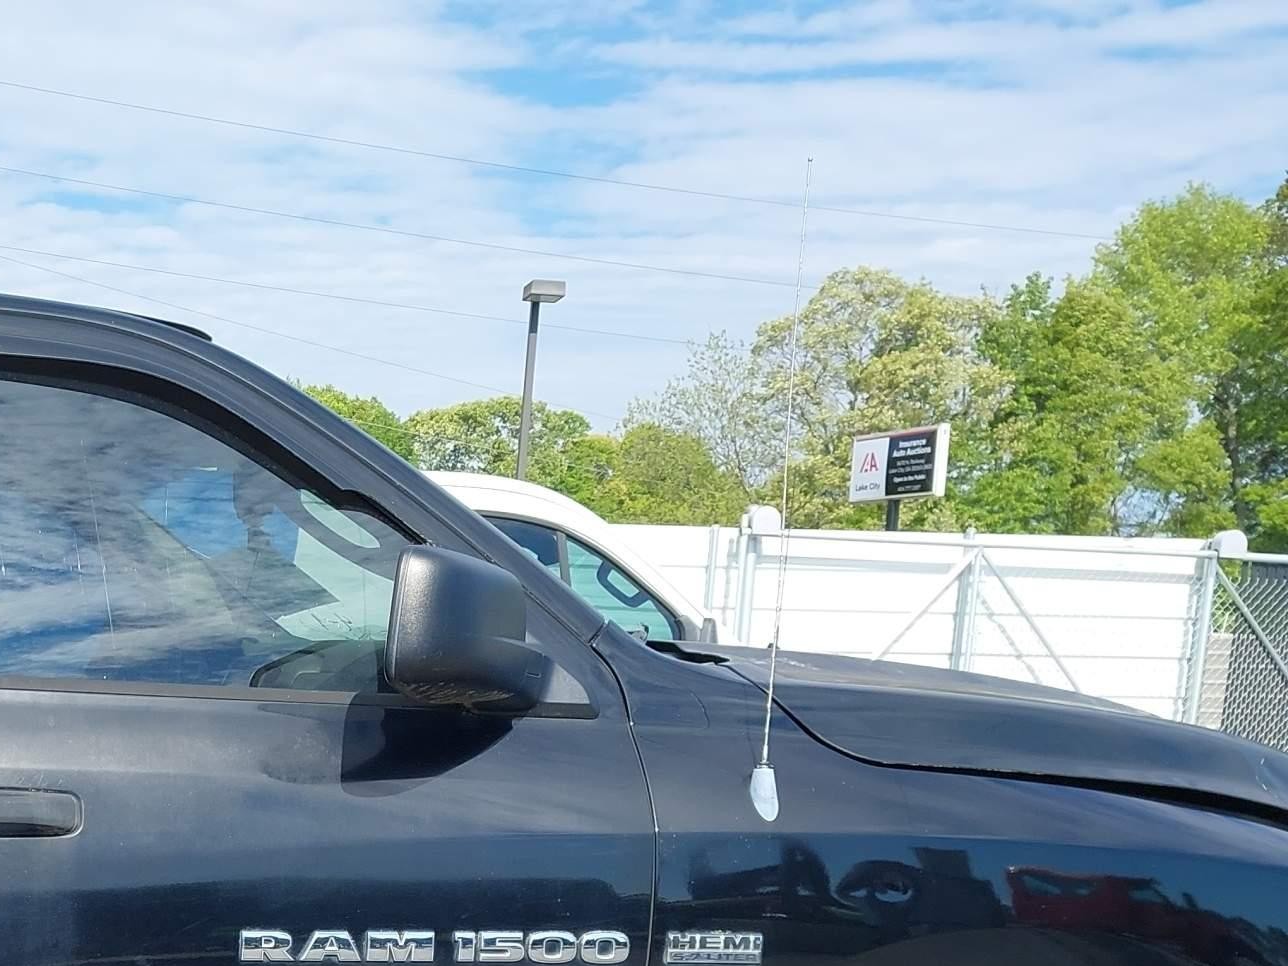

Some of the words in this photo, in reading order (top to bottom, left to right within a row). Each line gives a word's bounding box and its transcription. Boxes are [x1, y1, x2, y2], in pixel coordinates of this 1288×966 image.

[855, 484, 868, 492] Lake
[869, 482, 880, 490] City
[240, 930, 435, 962] RAM
[453, 930, 630, 964] 1500
[671, 934, 762, 951] HEMI
